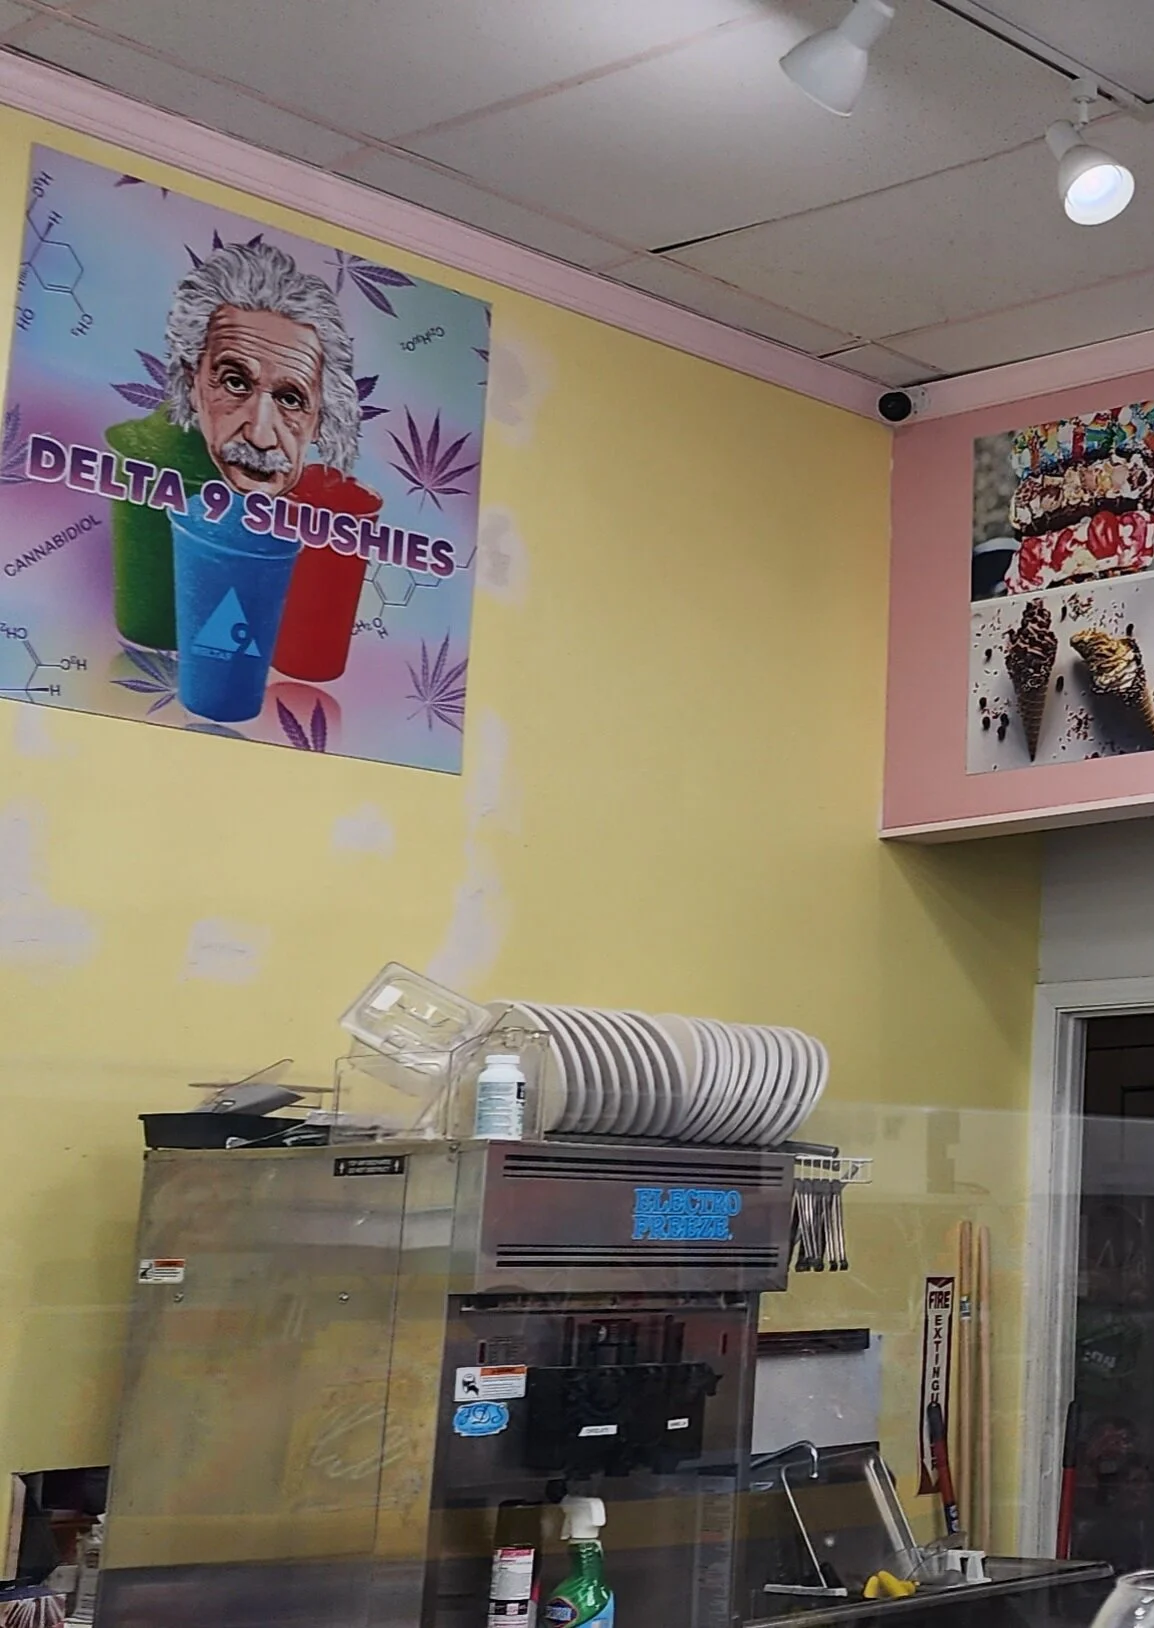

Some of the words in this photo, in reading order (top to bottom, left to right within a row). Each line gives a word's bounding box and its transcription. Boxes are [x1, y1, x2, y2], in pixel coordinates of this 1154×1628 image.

[26, 433, 188, 516] DELTA
[200, 479, 233, 523] 9
[241, 492, 456, 577] SLUSHIES
[4, 514, 102, 577] CANNABIDIOL
[633, 1188, 742, 1217] ELECTRO
[929, 1290, 951, 1309] FIRE
